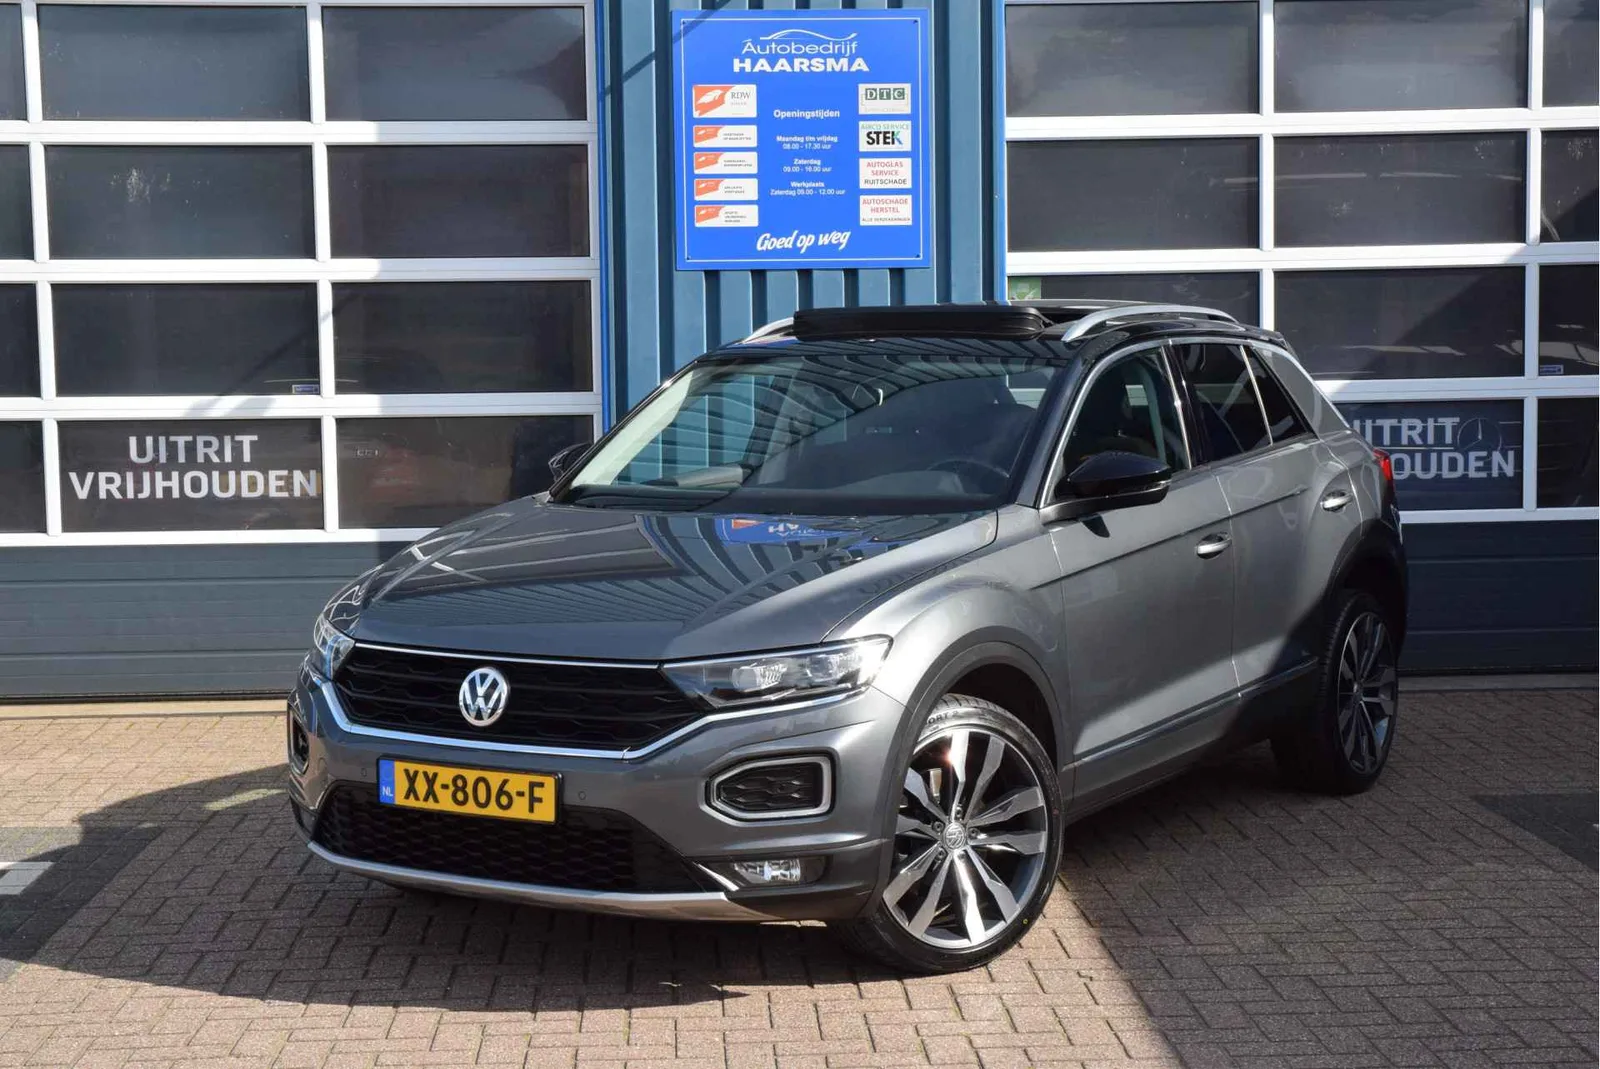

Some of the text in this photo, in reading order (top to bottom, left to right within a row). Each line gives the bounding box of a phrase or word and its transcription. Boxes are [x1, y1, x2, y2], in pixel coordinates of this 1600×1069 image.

[741, 40, 858, 57] Autobedrijf
[733, 58, 870, 72] HAARSMA
[731, 91, 751, 100] RDW
[866, 88, 905, 100] DTC
[773, 109, 840, 120] Openingstijden
[776, 135, 804, 143] Maandag
[817, 135, 838, 143] vrijdag
[866, 130, 903, 145] STEK
[793, 158, 821, 166] Zaterdag
[871, 169, 900, 177] SERVICE
[770, 189, 796, 197] Zaterdag
[756, 230, 852, 254] Goed op weg
[1353, 417, 1460, 446] ITRIT
[128, 434, 259, 464] UITRIT
[68, 469, 318, 500] VRIJHOUDEN
[382, 785, 393, 798] NL
[403, 768, 545, 814] XX-806-F
